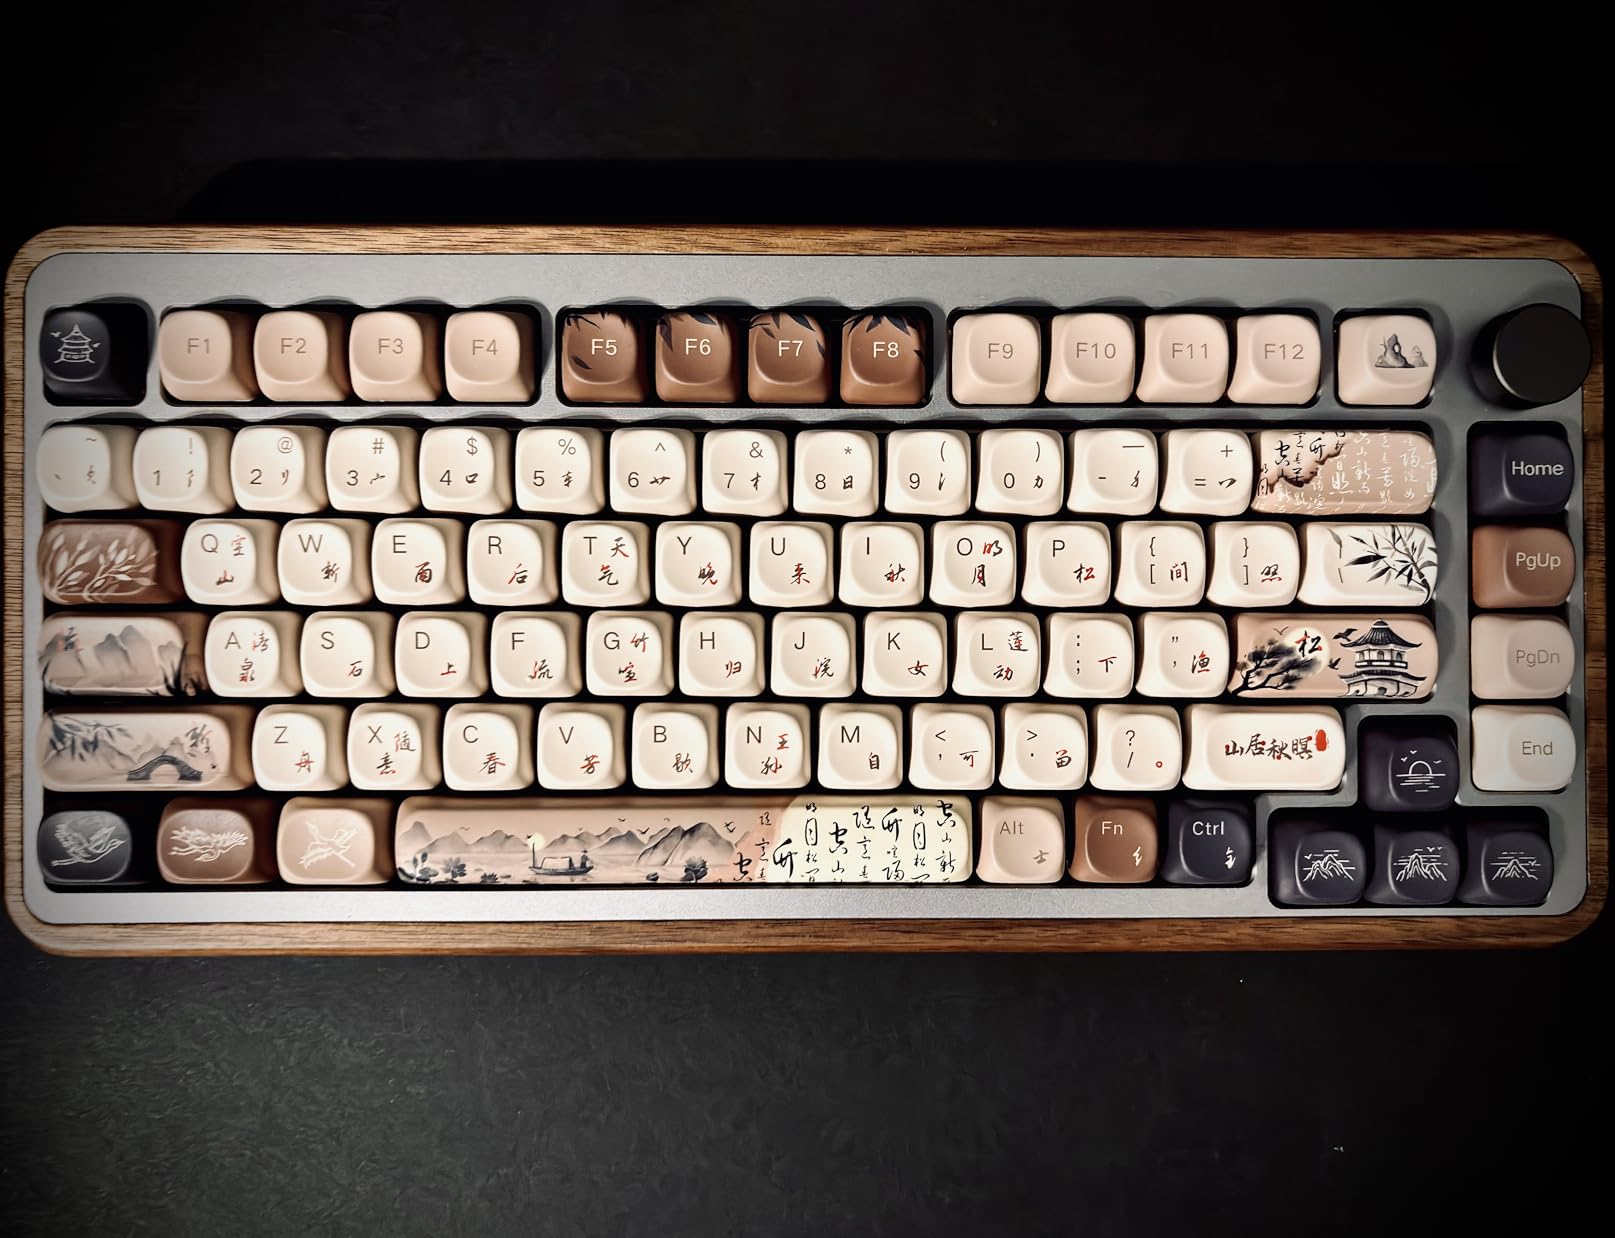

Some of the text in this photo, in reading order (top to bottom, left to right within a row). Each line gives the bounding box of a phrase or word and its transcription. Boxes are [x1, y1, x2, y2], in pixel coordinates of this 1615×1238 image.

[188, 338, 209, 354] F1
[281, 338, 306, 354] F2
[379, 338, 403, 354] F3
[473, 340, 498, 355] F4
[592, 339, 616, 355] F5
[686, 338, 710, 355] F6
[779, 340, 803, 356] F7
[874, 342, 899, 358] F8
[989, 343, 1013, 359] F9
[1077, 342, 1116, 358] F10
[1172, 343, 1207, 359] F11
[1265, 344, 1304, 360] F12
[277, 436, 294, 454] @
[371, 438, 385, 454] #
[466, 437, 478, 456] $
[557, 438, 577, 455] %
[749, 442, 763, 458] &
[1220, 445, 1233, 457] +
[250, 469, 262, 484] 2
[1512, 461, 1564, 475] Home
[154, 470, 160, 485] 1
[347, 470, 358, 486] 3
[440, 470, 452, 485] 4
[533, 471, 544, 486] 5
[628, 472, 639, 487] 6
[724, 473, 734, 488] 7
[815, 474, 826, 489] 8
[843, 476, 853, 489] 日
[910, 473, 920, 489] 9
[1004, 473, 1015, 488] 0
[201, 534, 218, 553] Q
[298, 534, 323, 552] W
[393, 535, 406, 553] E
[488, 536, 501, 554] R
[584, 537, 597, 554] T
[610, 537, 629, 559] 天
[677, 537, 692, 555] Y
[771, 537, 785, 555] U
[957, 538, 972, 556] O
[1053, 540, 1065, 557] P
[1150, 537, 1155, 557] {
[1243, 538, 1248, 558] }
[1516, 552, 1560, 570] PgUp
[215, 570, 234, 586] 山
[415, 562, 432, 583] 雨
[508, 563, 527, 584] 后
[599, 565, 618, 585] 气
[698, 564, 718, 585] 晚
[791, 563, 810, 584] 来
[884, 564, 905, 582] 秋
[972, 564, 986, 587] 月
[1074, 564, 1095, 583] 松
[1150, 564, 1155, 584] [
[1170, 562, 1188, 582] 间
[1244, 565, 1248, 585] ]
[1261, 564, 1282, 582] 照
[225, 632, 240, 649] A
[321, 631, 334, 649] S
[416, 632, 430, 649] D
[512, 632, 524, 650] F
[604, 632, 619, 650] G
[630, 633, 648, 652] 竹
[700, 632, 715, 649] H
[795, 632, 805, 649] J
[888, 633, 900, 650] K
[982, 633, 993, 650] L
[1008, 632, 1029, 652] 莲
[1294, 630, 1324, 656] 松
[1098, 657, 1117, 672] 下
[1192, 651, 1210, 673] 渔
[1516, 650, 1560, 667] PgDn
[349, 661, 362, 677] 石
[441, 663, 456, 675] 上
[529, 659, 553, 679] 流
[726, 661, 741, 677] 归
[908, 660, 928, 676] 女
[993, 665, 1013, 680] 动
[274, 726, 288, 744] Z
[368, 726, 382, 743] X
[463, 725, 478, 743] C
[559, 727, 574, 744] V
[654, 726, 667, 743] B
[747, 726, 761, 743] N
[777, 734, 789, 750] 王
[841, 726, 859, 743] M
[936, 730, 945, 741] <
[1027, 730, 1037, 740] >
[1126, 730, 1135, 746] ?
[1225, 733, 1313, 760] 山居秋暝
[1522, 741, 1552, 755] End
[295, 752, 314, 772] 舟
[481, 752, 505, 774] 春
[581, 755, 600, 774] 芳
[673, 753, 693, 773] 歇
[761, 757, 782, 775] 孙
[869, 752, 879, 769] 自
[960, 751, 978, 767] 可
[1127, 752, 1133, 768] /
[1000, 821, 1024, 834] Alt
[1102, 821, 1122, 835] Fn
[1193, 821, 1224, 835] Ctrl
